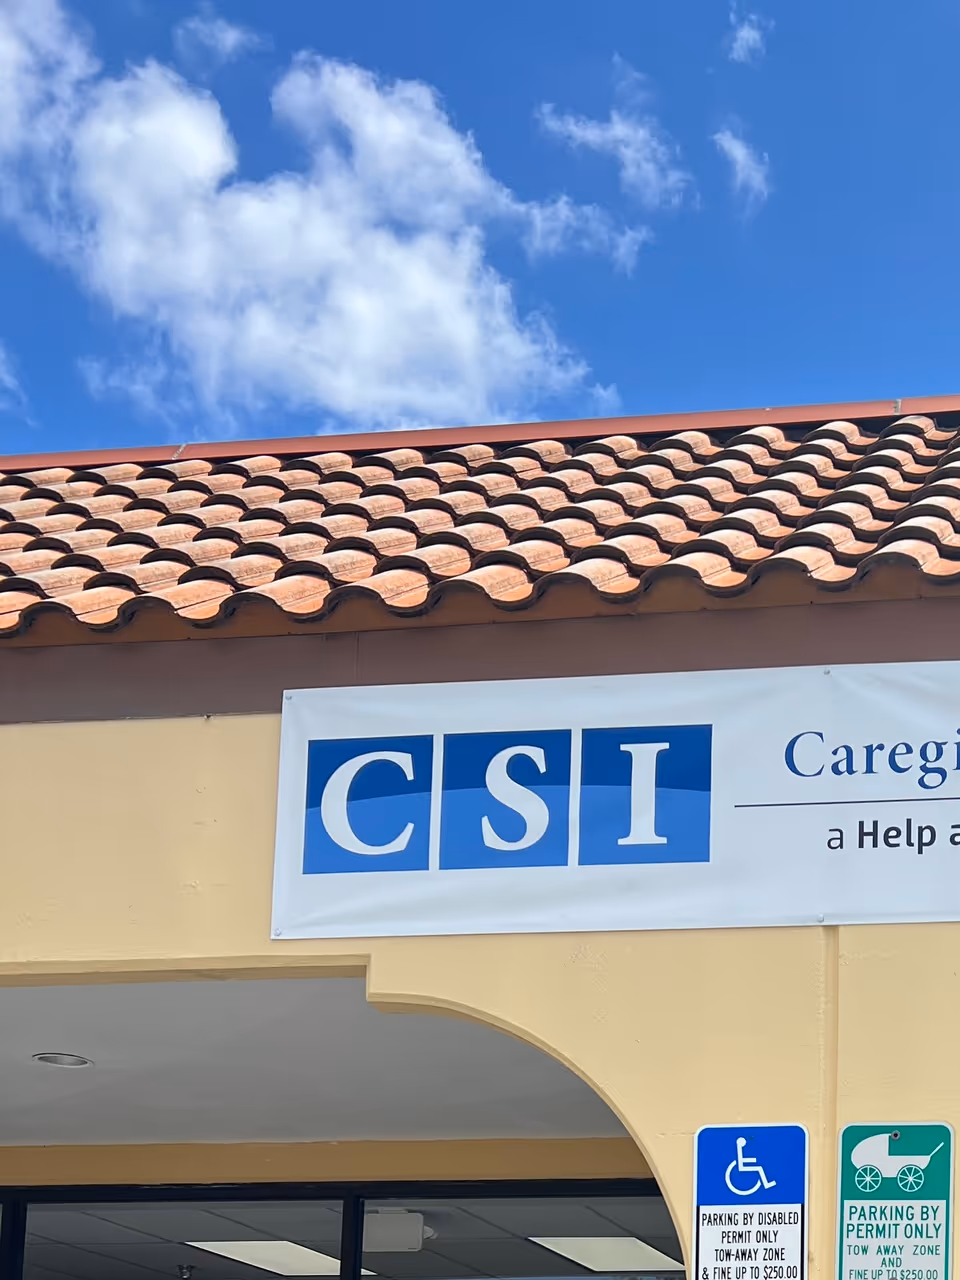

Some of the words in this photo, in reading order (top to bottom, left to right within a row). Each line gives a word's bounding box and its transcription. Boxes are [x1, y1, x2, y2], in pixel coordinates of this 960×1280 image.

[320, 741, 670, 857] CSI
[827, 827, 844, 850] a
[858, 818, 937, 855] Help
[701, 1212, 739, 1227] PARKING
[743, 1212, 755, 1226] BY
[758, 1211, 799, 1226] DISABLED
[849, 1205, 915, 1221] PARKING
[920, 1205, 940, 1221] BY
[721, 1230, 752, 1244] PERMIT
[755, 1230, 779, 1244] ONLY
[846, 1223, 900, 1239] PERMIT
[904, 1223, 942, 1239] ONLY
[714, 1248, 759, 1262] TOW-AWAY
[762, 1247, 786, 1261] ZONE
[847, 1244, 869, 1256] TOW
[876, 1244, 904, 1256] AWAY
[912, 1244, 941, 1256] ZONE
[880, 1257, 902, 1268] AND
[701, 1266, 709, 1280] &
[713, 1266, 732, 1280] FINE
[735, 1266, 747, 1280] UP
[749, 1266, 760, 1280] TO
[763, 1265, 798, 1280] $250.00
[849, 1269, 869, 1280] FINE
[871, 1269, 883, 1280] UP
[886, 1269, 898, 1280] TO
[900, 1269, 939, 1280] $250.00
